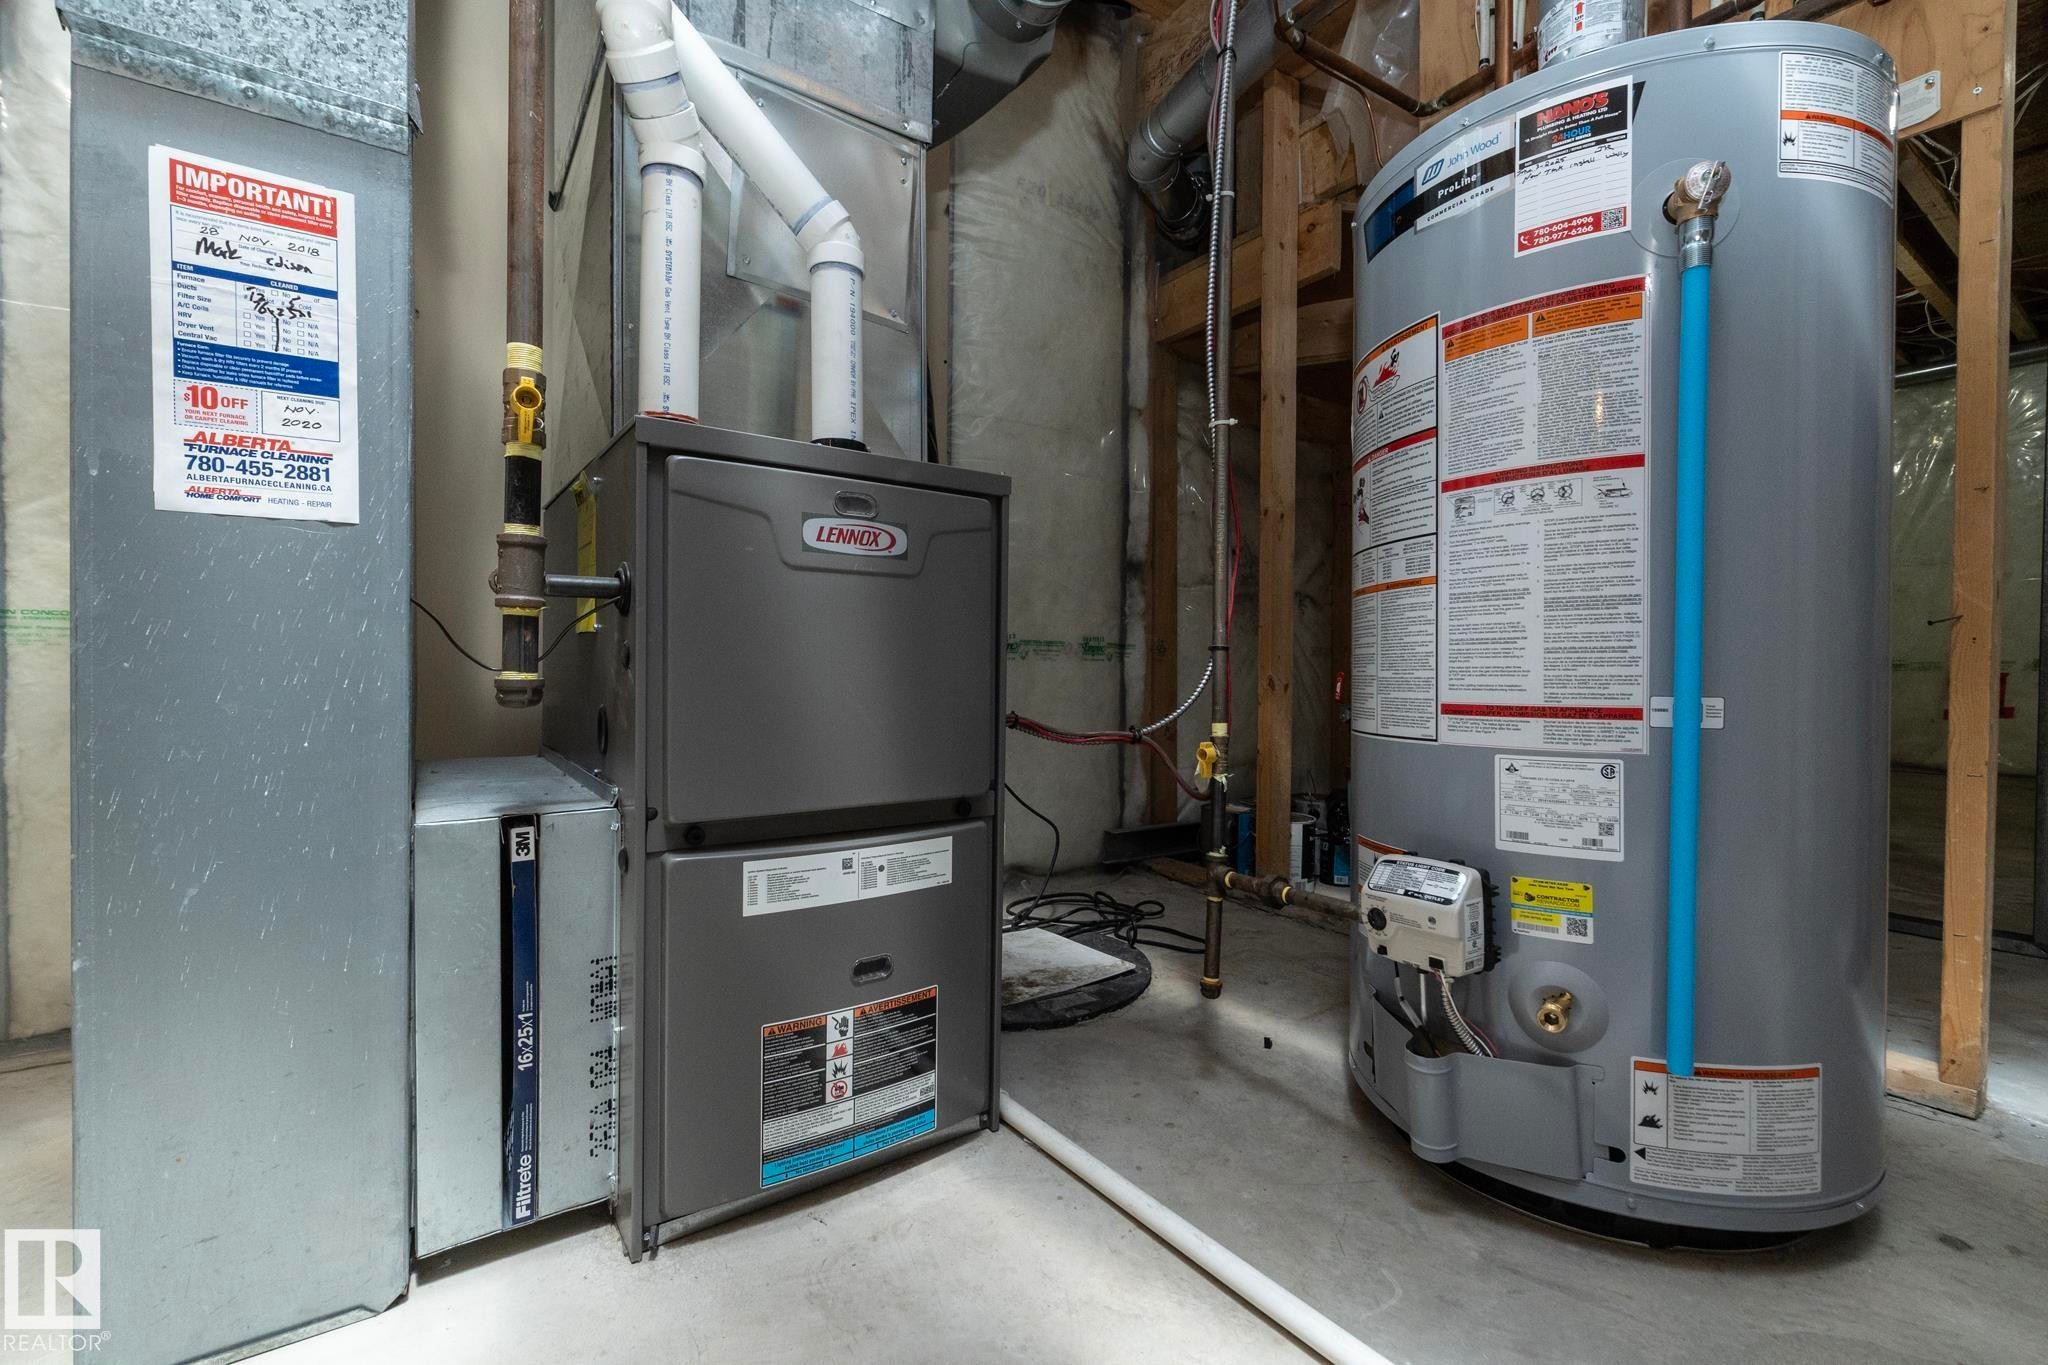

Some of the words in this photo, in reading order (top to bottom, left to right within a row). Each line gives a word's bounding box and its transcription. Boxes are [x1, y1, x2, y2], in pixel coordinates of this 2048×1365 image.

[1537, 92, 1609, 128] NANO'S
[1537, 120, 1564, 132] PLUMBING
[1573, 110, 1597, 121] HEATING
[1598, 106, 1608, 114] LTD
[1447, 151, 1469, 168] John
[1471, 136, 1499, 154] Wood
[176, 164, 332, 218] IMPORTANT!
[1437, 173, 1478, 199] ProLine
[1427, 198, 1468, 222] COMMERCIAL
[1470, 185, 1495, 200] GRADE
[1533, 216, 1594, 237] 780-604-4996
[1533, 224, 1594, 246] 780-977-6266
[200, 226, 219, 236] 28
[287, 242, 320, 257] 2018
[177, 263, 194, 272] ITEM
[270, 280, 299, 291] CLEANED
[177, 273, 205, 283] Furnace
[177, 282, 197, 291] Ducts
[177, 291, 195, 300] Filter
[197, 295, 212, 303] Size
[177, 301, 190, 309] A/C
[192, 303, 209, 312] Coils
[177, 311, 192, 319] HRV
[178, 320, 197, 329] Dryer
[198, 323, 215, 331] Vent
[178, 330, 203, 339] Central
[183, 384, 218, 410] $10
[220, 396, 248, 410] OFF
[184, 408, 201, 416] YOUR
[195, 415, 218, 423] CARPET
[219, 418, 248, 427] CLEANING
[282, 418, 322, 430] 2020
[190, 431, 292, 452] ALBERTA
[184, 443, 258, 458] FURNACE
[260, 450, 333, 465] CLEANING
[184, 454, 331, 483] 780-455-2881
[186, 473, 332, 492] ALBERTAFURNACECLEANING.CA
[187, 485, 242, 496] ALBERTA
[185, 492, 215, 500] HOME
[216, 494, 262, 503] COMFORT
[267, 497, 299, 506] HEATING
[307, 500, 332, 509] REPAIR
[816, 526, 882, 548] LENNOX
[515, 831, 531, 857] 3M
[1536, 894, 1580, 903] CONTRACTOR
[868, 990, 931, 1012] AVERTISSEMENT
[777, 1018, 823, 1034] WARNING
[518, 1012, 534, 1072] 16x25x1
[516, 1154, 533, 1220] Filtrete
